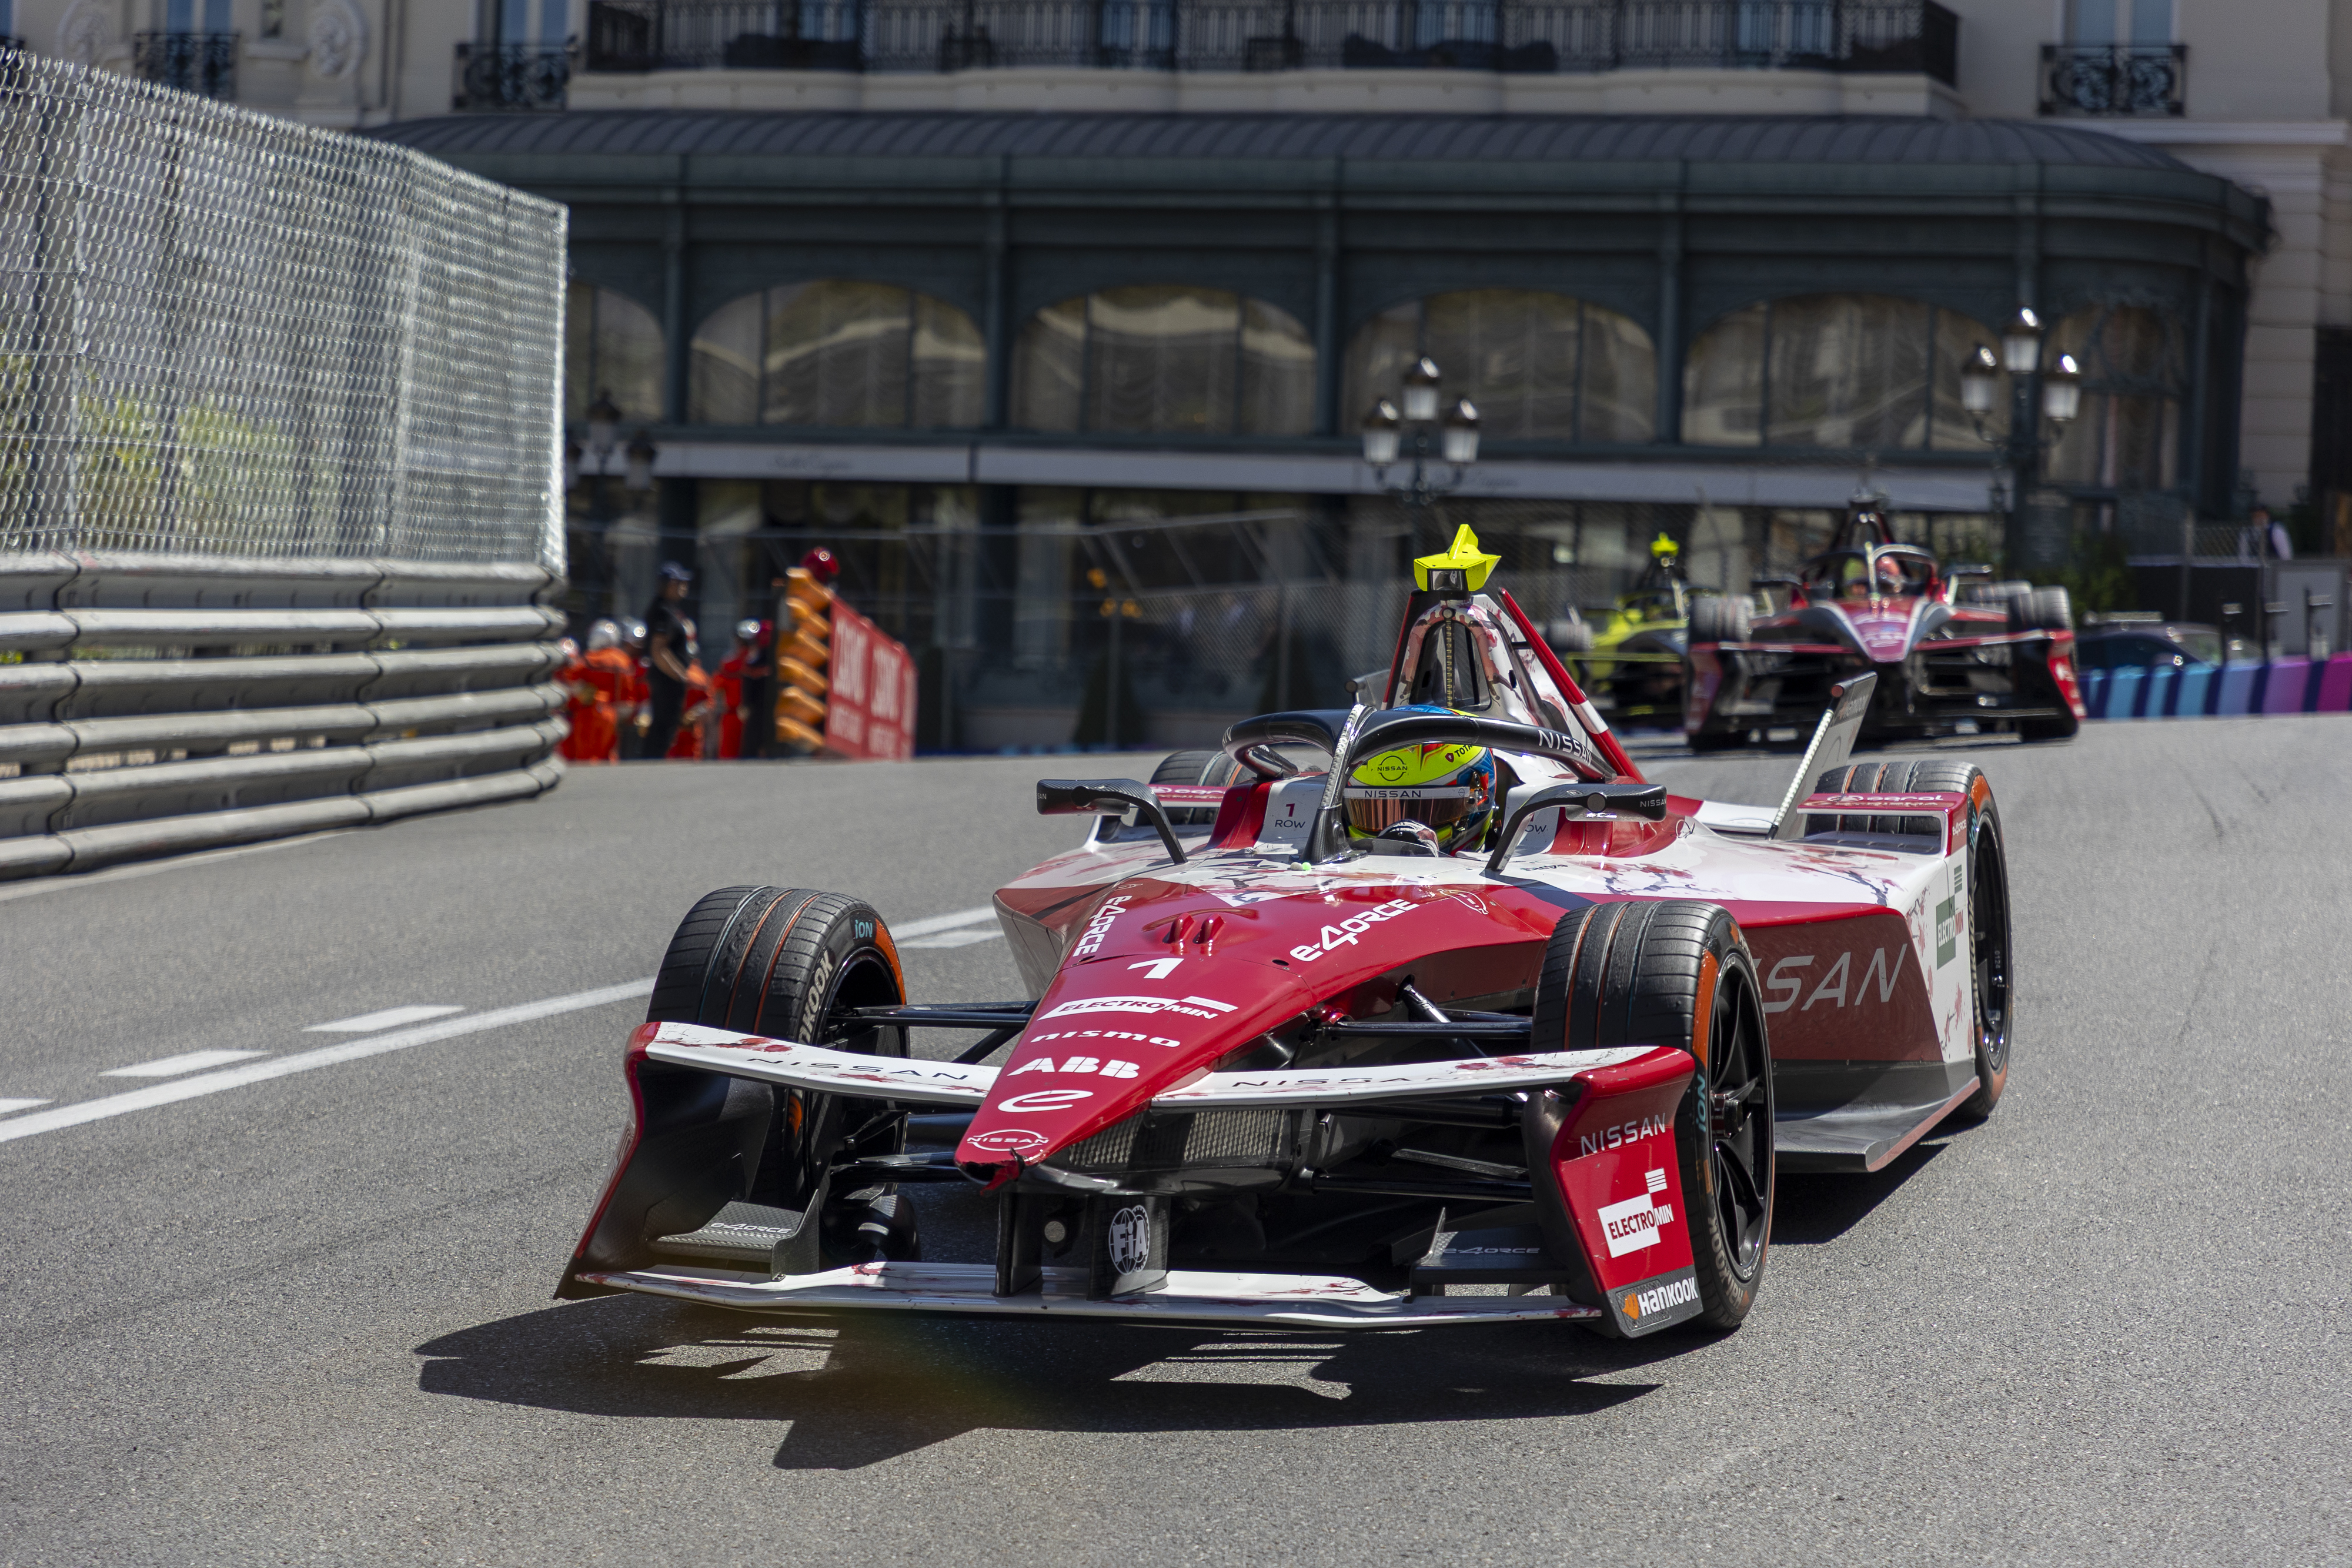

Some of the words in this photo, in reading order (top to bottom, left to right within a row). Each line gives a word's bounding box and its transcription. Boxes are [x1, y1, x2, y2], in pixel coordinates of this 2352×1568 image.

[1538, 729, 1592, 766] NISSAN
[1365, 790, 1421, 798] NISSAN
[1640, 798, 1667, 807] NISSAN
[1285, 803, 1295, 817] 1
[1274, 819, 1305, 828] ROW
[1525, 824, 1547, 833] OW
[1127, 958, 1185, 979] 1
[1058, 1001, 1218, 1019] ELECTROMIN
[1030, 1030, 1180, 1048] nismo
[747, 1058, 969, 1080] NISSAN
[1007, 1057, 1140, 1079] ABB
[1232, 1076, 1461, 1088] NISSAN
[1581, 1112, 1666, 1157] NISSAN
[1608, 1204, 1675, 1241] ELECTROMIN
